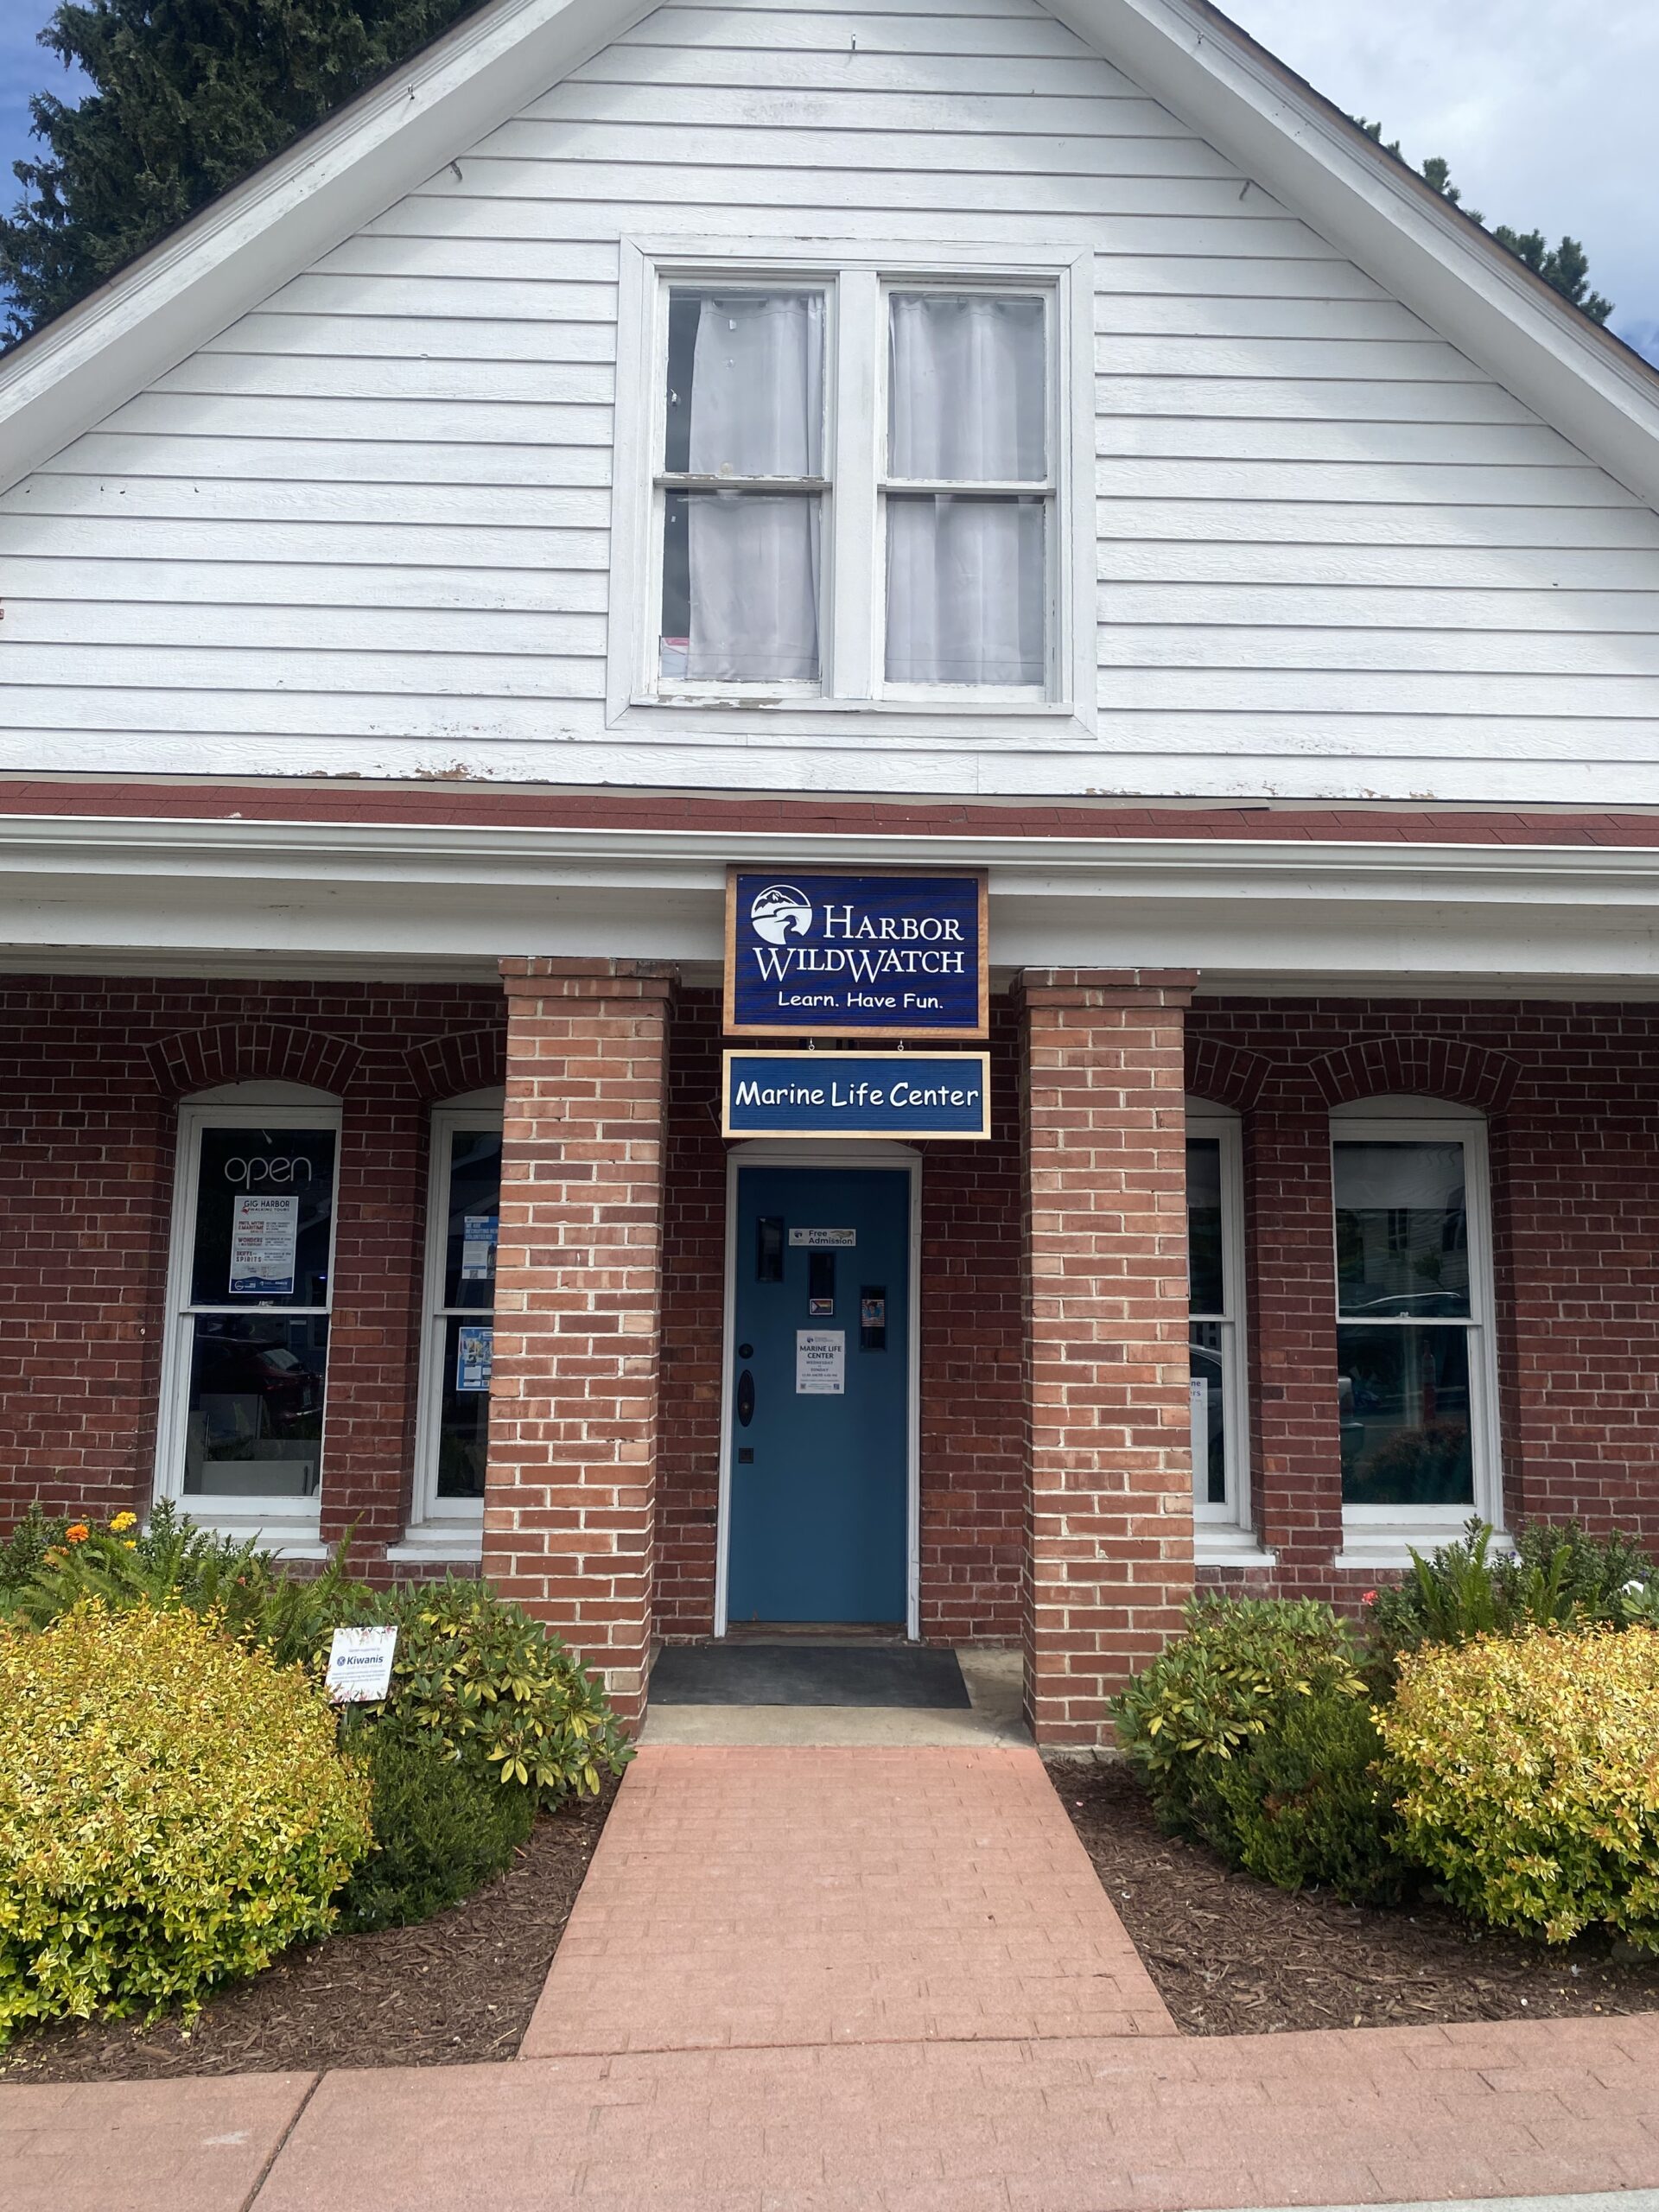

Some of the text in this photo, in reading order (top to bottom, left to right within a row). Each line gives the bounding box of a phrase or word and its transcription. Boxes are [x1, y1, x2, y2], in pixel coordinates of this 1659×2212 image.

[823, 905, 964, 941] HARBOR
[752, 947, 965, 983] WILDWATCH
[778, 991, 944, 1009] Learn. Have Fun.
[735, 1081, 979, 1107] Marine Life Center
[224, 1156, 312, 1190] open
[346, 1655, 385, 1665] Kiwanis
